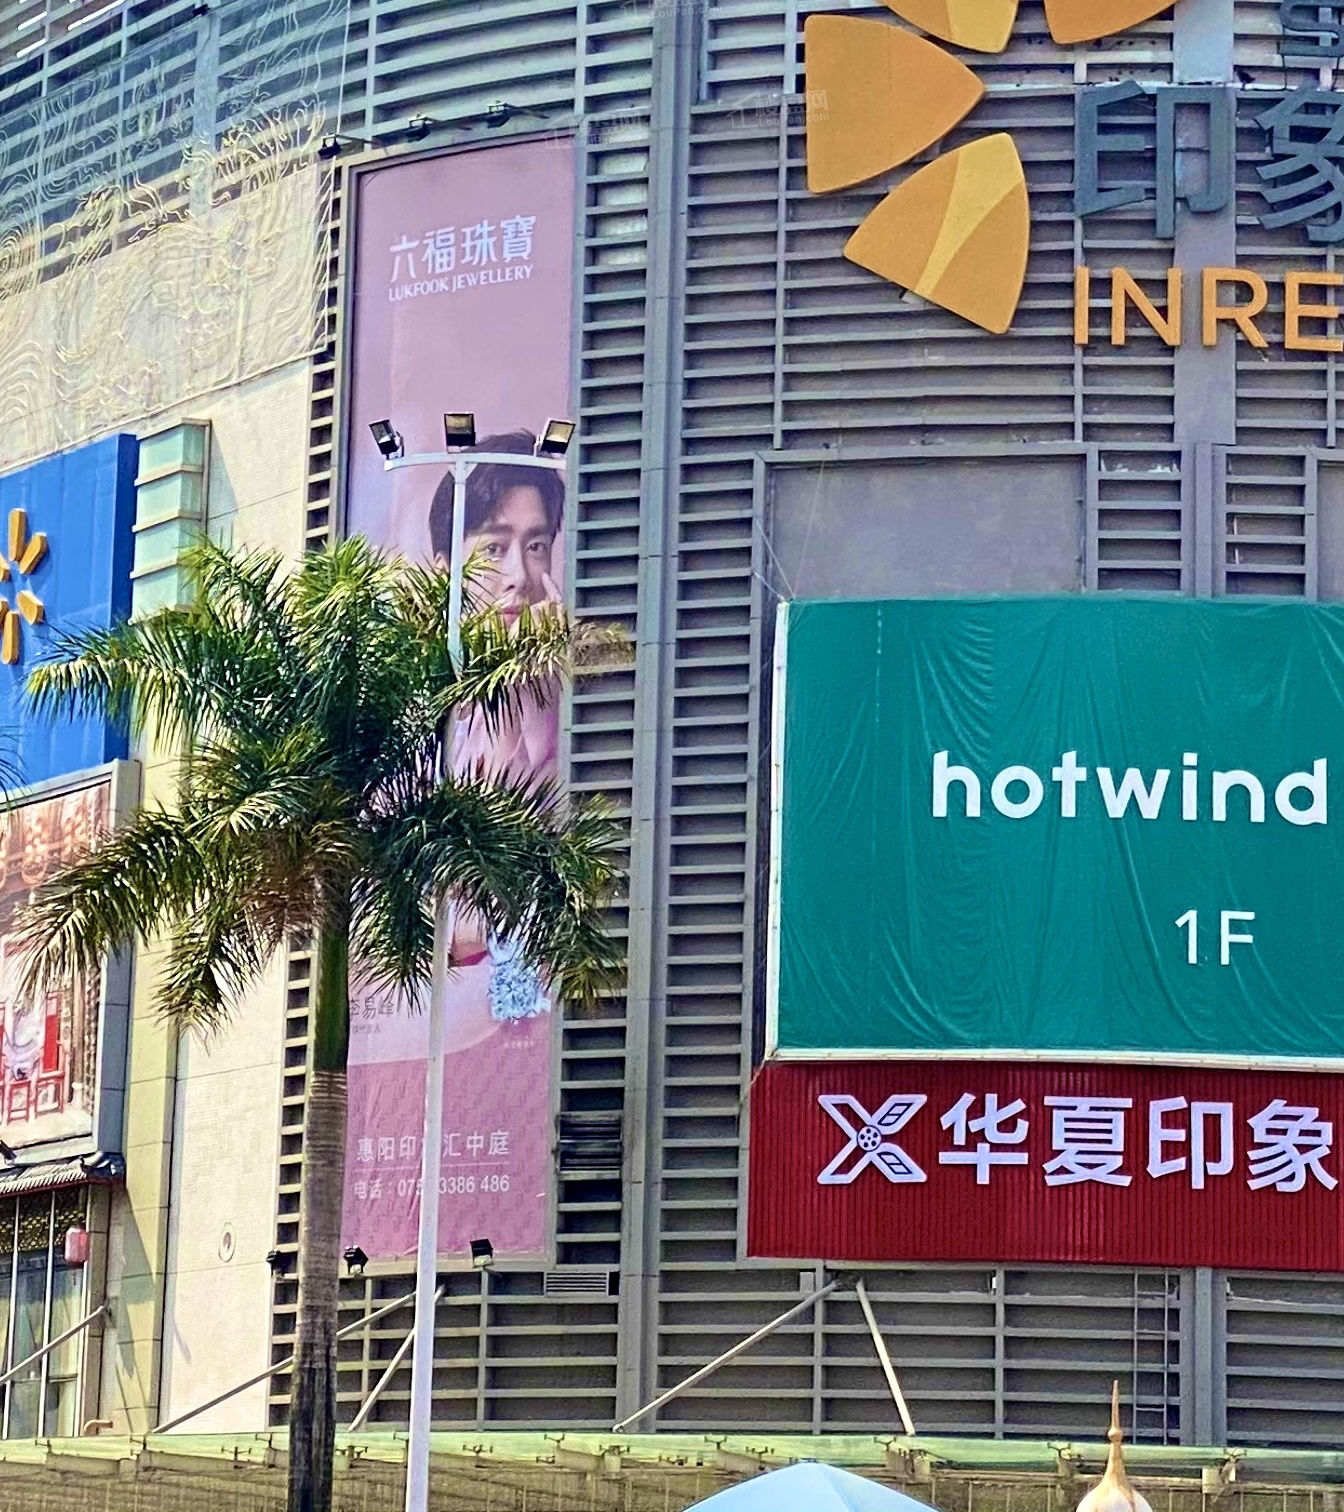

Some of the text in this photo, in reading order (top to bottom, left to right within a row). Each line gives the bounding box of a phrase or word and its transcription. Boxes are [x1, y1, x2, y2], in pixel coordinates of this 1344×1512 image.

[389, 214, 537, 283] 六福珠寶
[388, 264, 534, 302] LUKFOOK JEWELLERY
[932, 750, 1328, 825] hotwind
[1175, 910, 1256, 966] 1F
[356, 1130, 510, 1163] 惠阳印汇中庭
